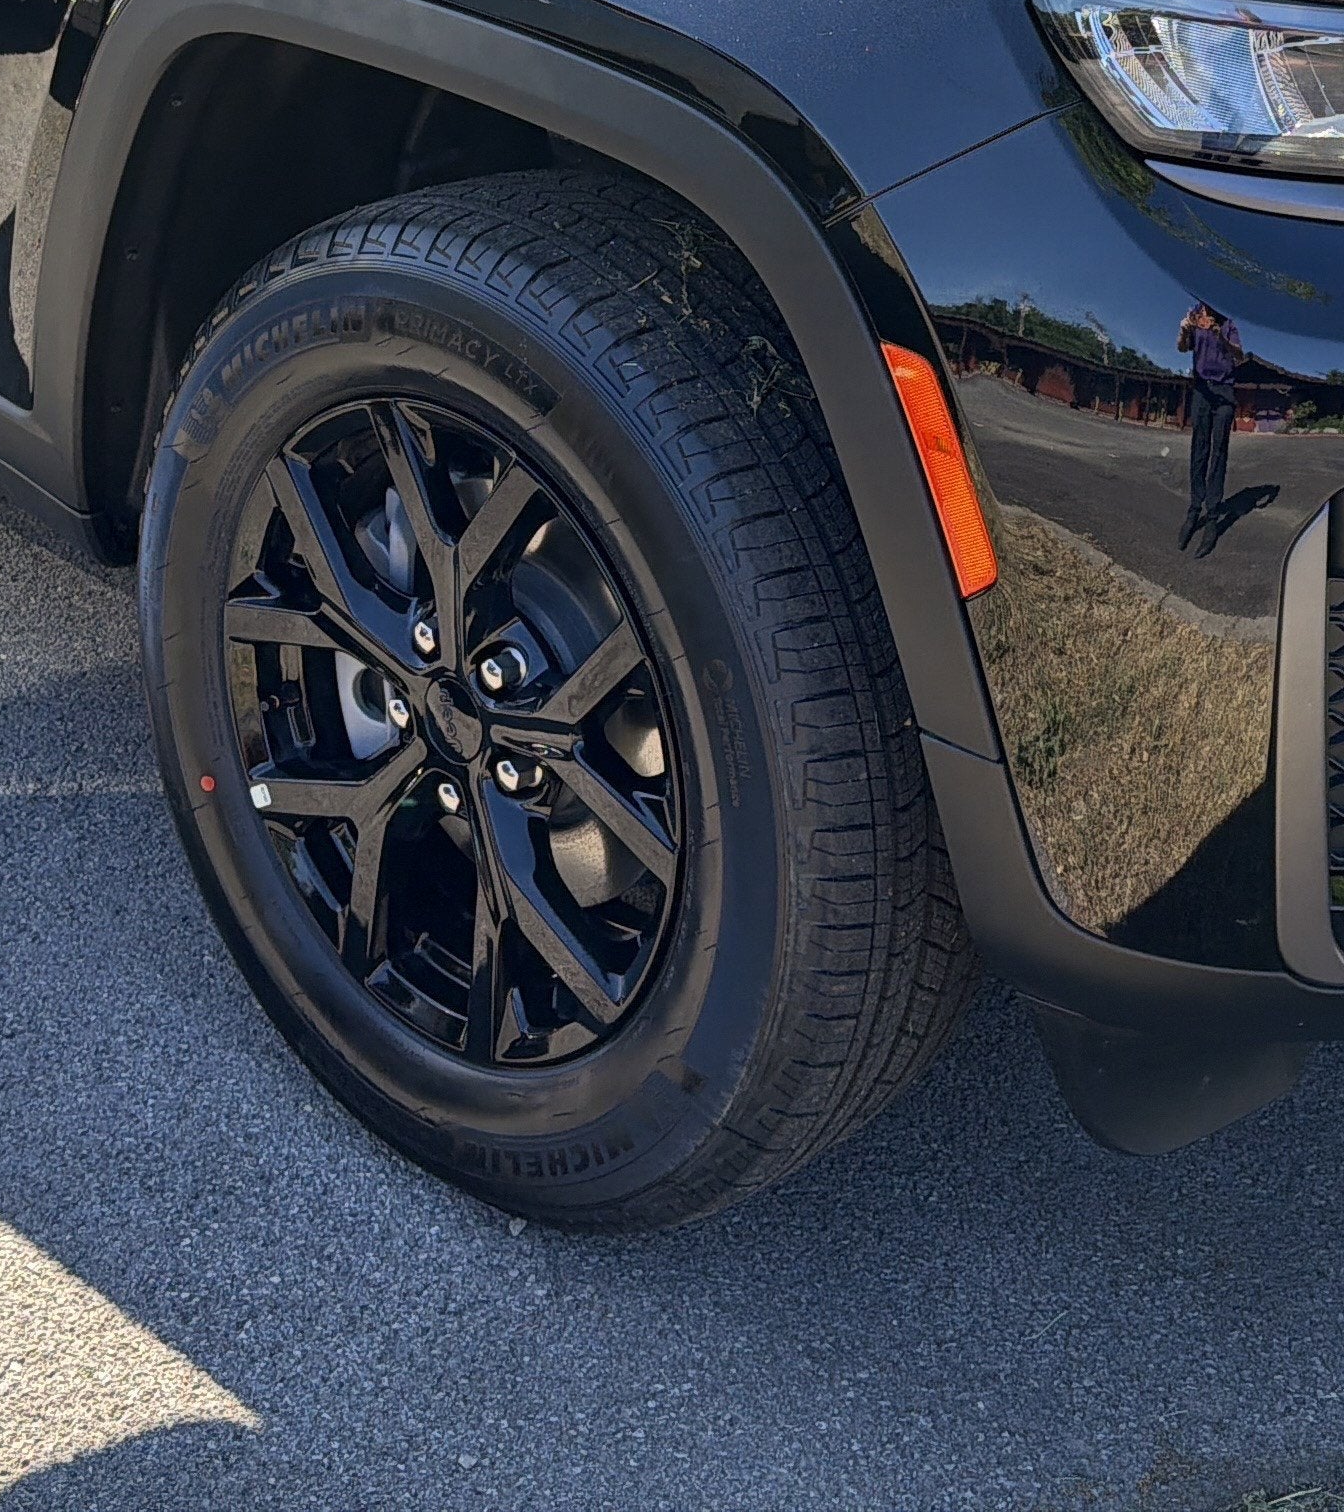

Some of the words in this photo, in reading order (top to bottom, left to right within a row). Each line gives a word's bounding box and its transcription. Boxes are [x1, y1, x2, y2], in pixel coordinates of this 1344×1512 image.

[219, 300, 367, 390] MICHELIN
[394, 308, 502, 370] PRIMACY
[504, 363, 538, 397] LTX
